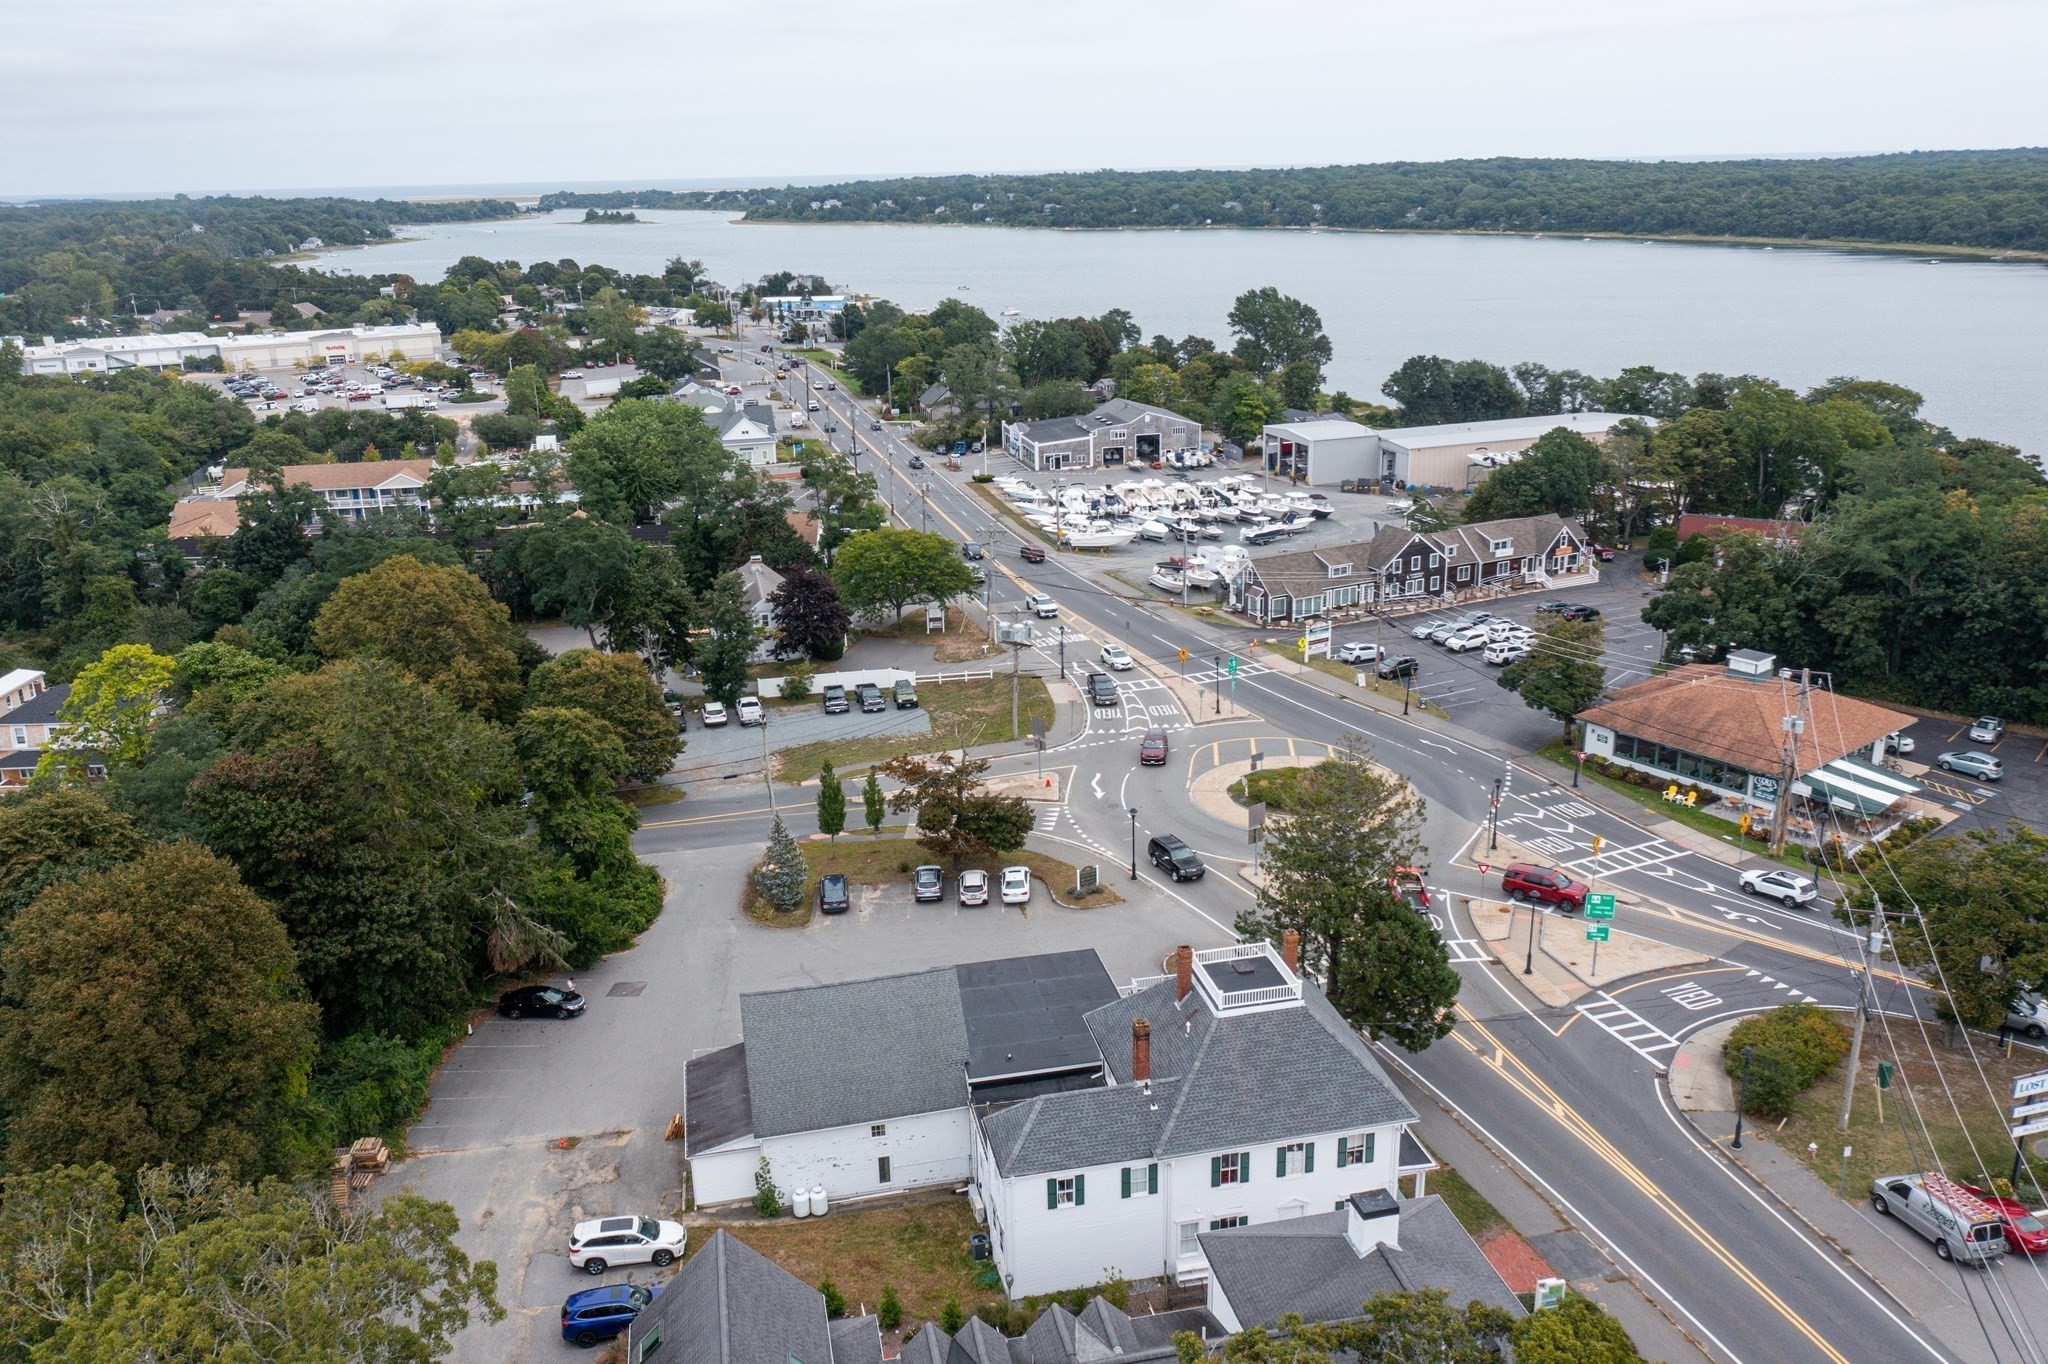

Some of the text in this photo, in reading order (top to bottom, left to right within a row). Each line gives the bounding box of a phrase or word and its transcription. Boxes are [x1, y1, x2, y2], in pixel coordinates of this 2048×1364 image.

[1094, 708, 1123, 719] YIELD
[1149, 704, 1180, 716] YIELD
[1545, 802, 1596, 819] YIELD
[1521, 836, 1575, 855] YIELD
[1660, 981, 1723, 1010] YIELD
[2019, 1079, 2047, 1093] LOST
